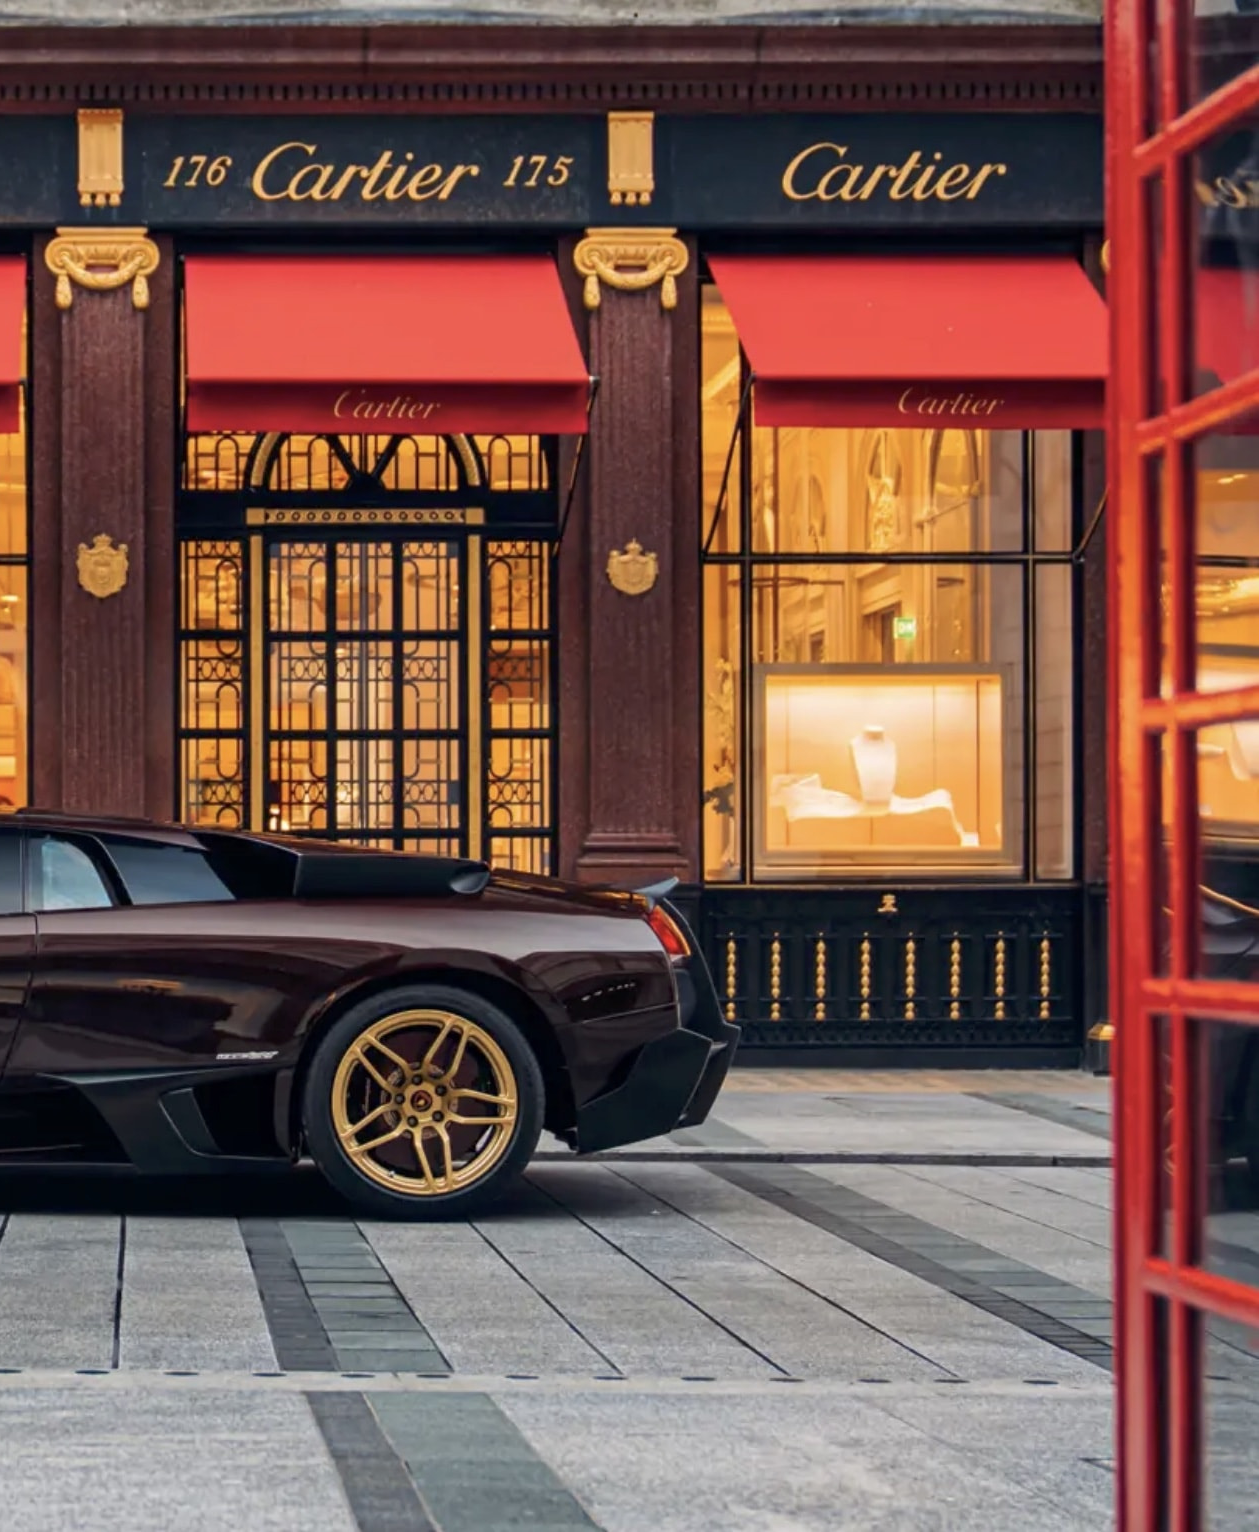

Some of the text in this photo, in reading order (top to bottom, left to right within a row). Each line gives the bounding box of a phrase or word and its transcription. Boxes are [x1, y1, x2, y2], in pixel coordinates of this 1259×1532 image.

[164, 141, 573, 203] 176 Cartier 175
[780, 142, 1007, 202] Cartier
[333, 389, 441, 419] Cartier
[897, 386, 1005, 415] Cartier
